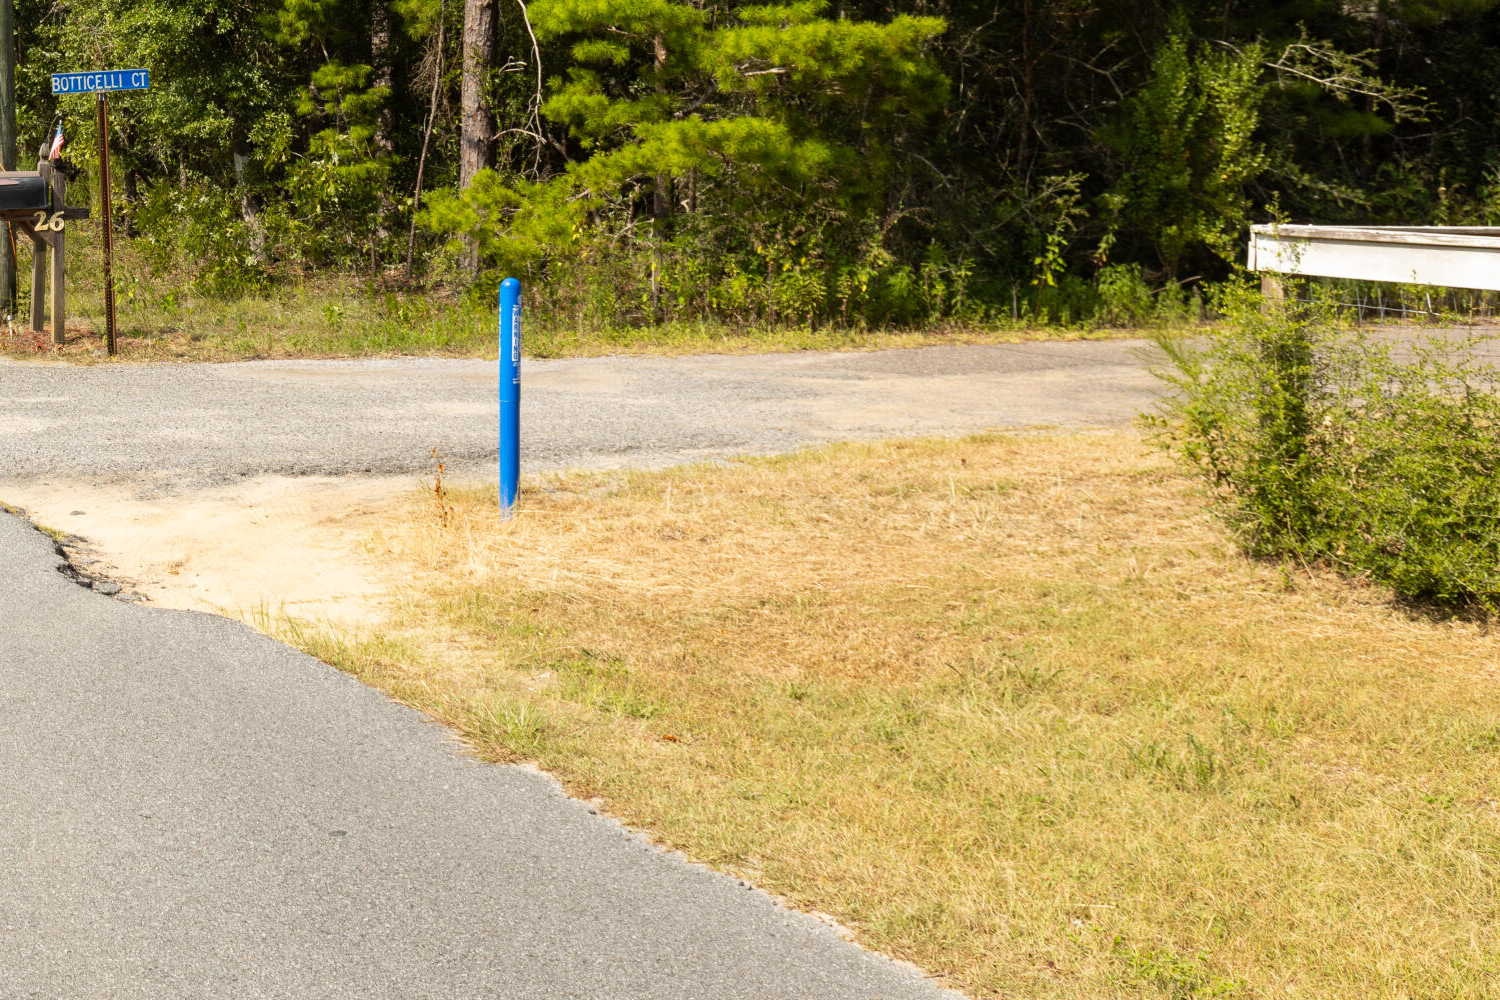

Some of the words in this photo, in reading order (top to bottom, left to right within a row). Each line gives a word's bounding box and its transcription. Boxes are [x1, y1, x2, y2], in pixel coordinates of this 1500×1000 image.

[52, 74, 122, 92] BOTTICELLI
[131, 72, 147, 87] CT
[34, 210, 65, 232] 26
